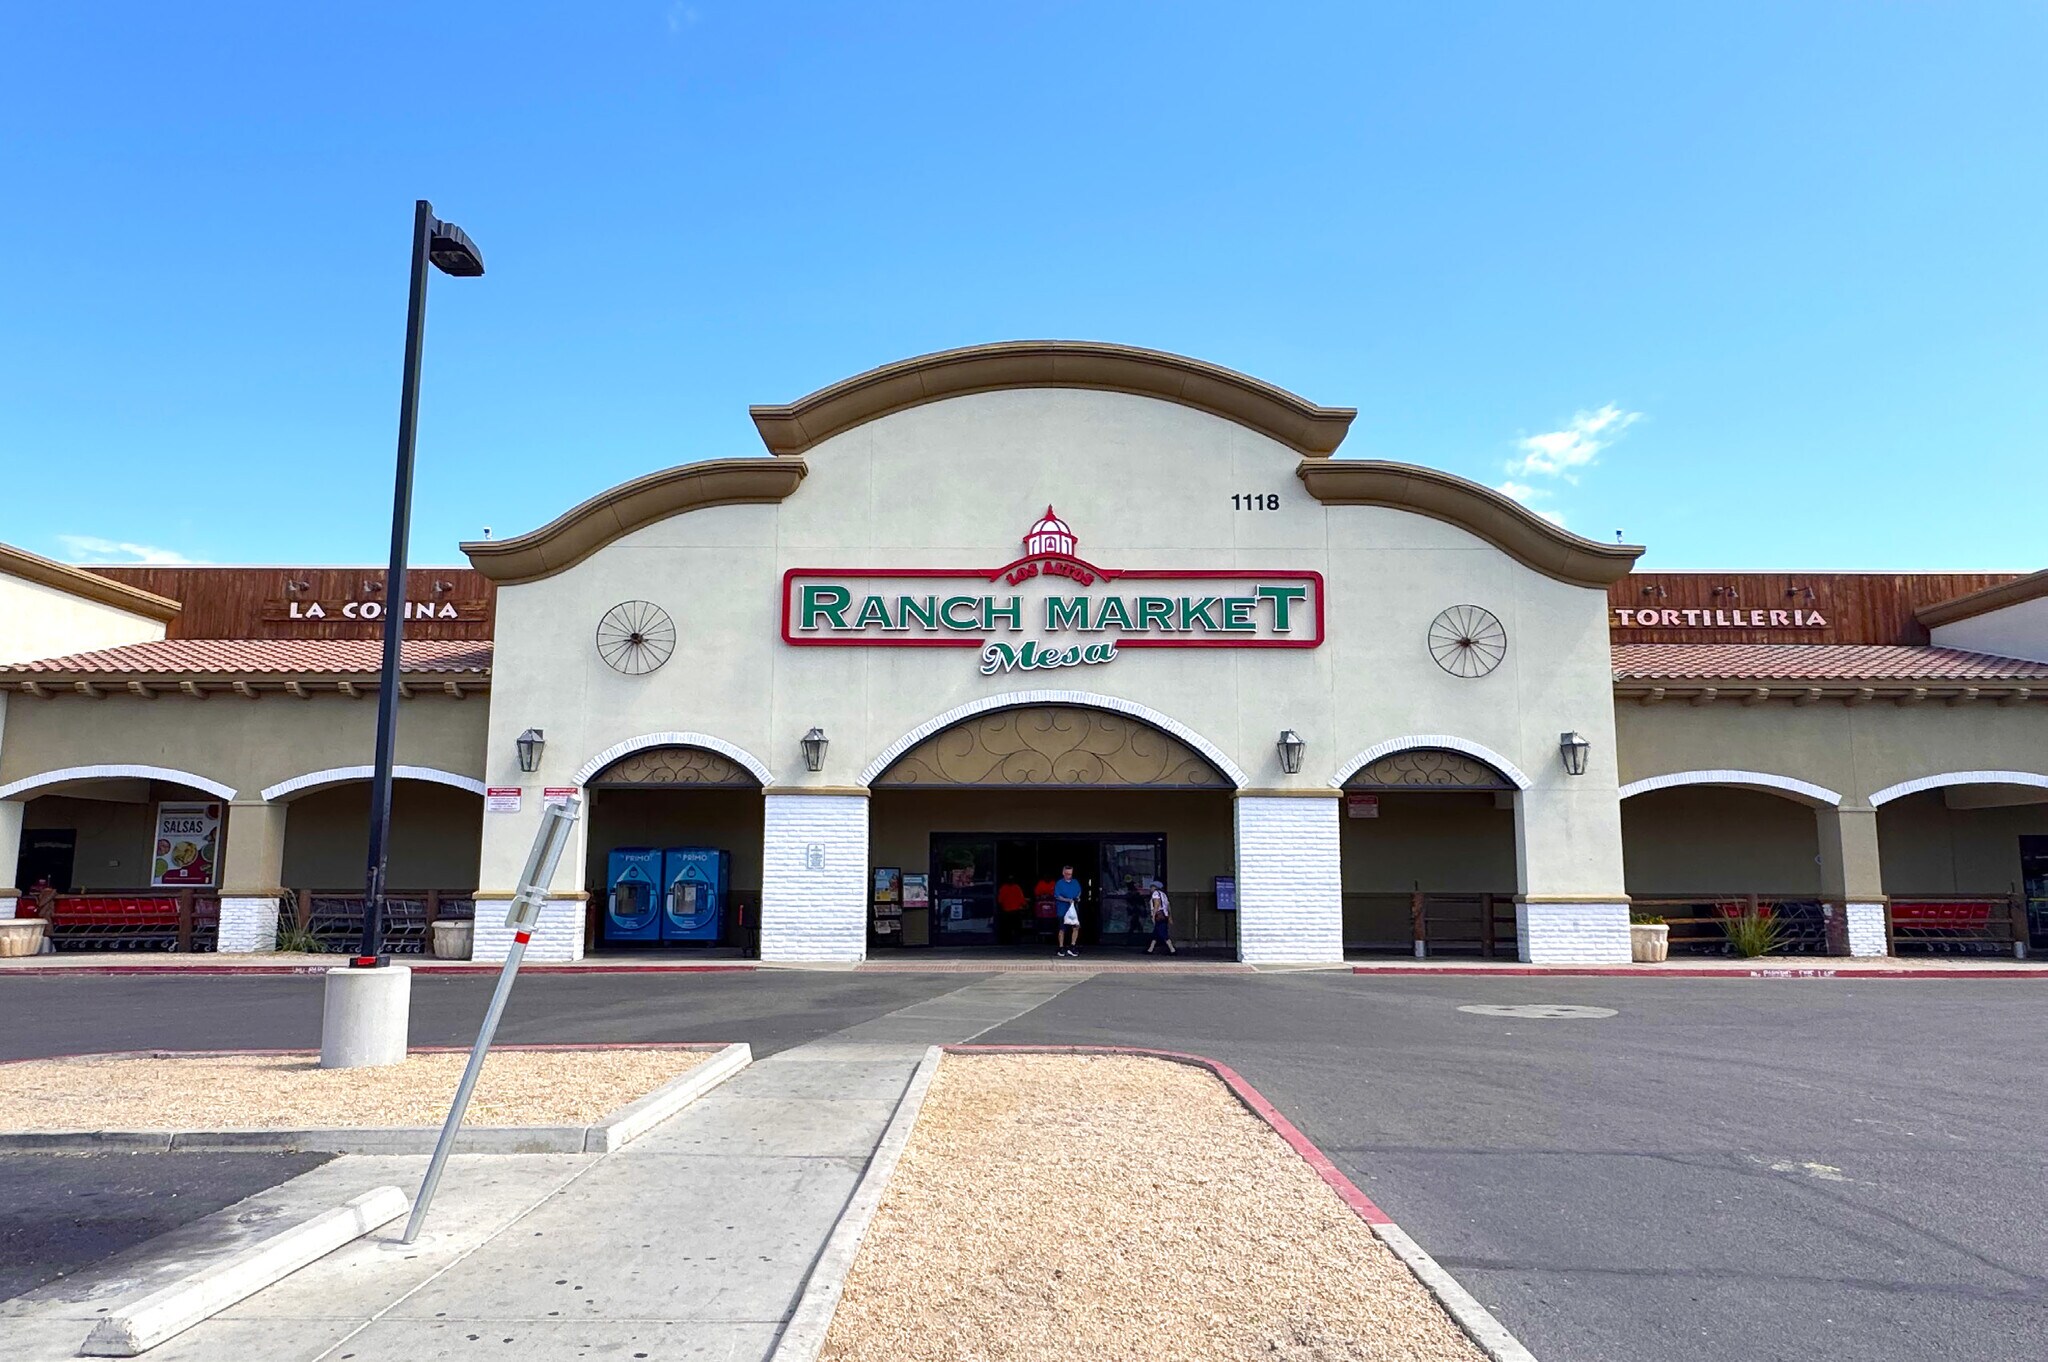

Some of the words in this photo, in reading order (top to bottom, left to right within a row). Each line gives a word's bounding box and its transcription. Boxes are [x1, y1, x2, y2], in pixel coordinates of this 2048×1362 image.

[1231, 494, 1280, 511] 1118
[1006, 563, 1038, 586] LOS
[1042, 561, 1095, 587] ALTOS
[290, 602, 326, 619] LA
[342, 602, 458, 619] COINA
[799, 584, 1024, 631] RANCH
[1044, 585, 1307, 632] MARKET
[1615, 609, 1827, 626] TORTILLERIA
[980, 639, 1118, 675] Mesa
[163, 820, 203, 833] SALSAS
